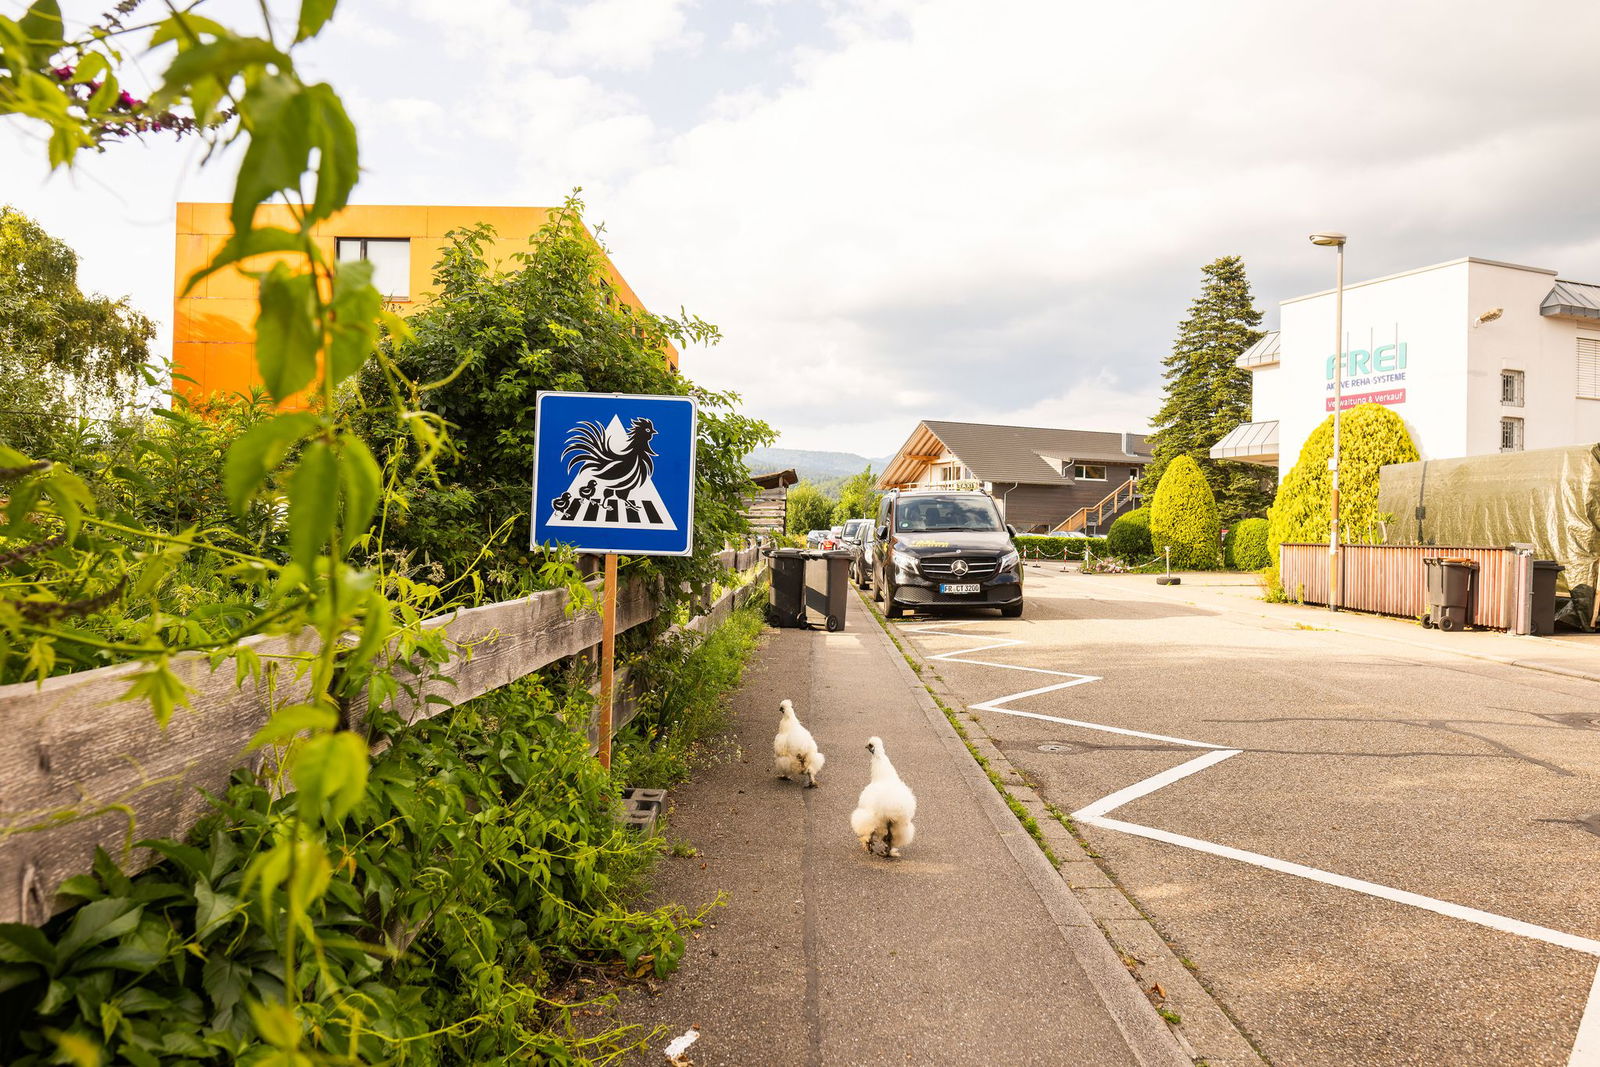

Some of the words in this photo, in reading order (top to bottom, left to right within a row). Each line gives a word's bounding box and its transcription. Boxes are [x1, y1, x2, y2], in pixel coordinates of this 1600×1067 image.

[1326, 342, 1407, 380] FREI
[1326, 381, 1349, 391] AKVE
[1351, 377, 1371, 388] REHA
[1373, 372, 1406, 385] SYSTEME
[1327, 397, 1366, 407] Vewaltung
[1374, 392, 1402, 402] Verkauf
